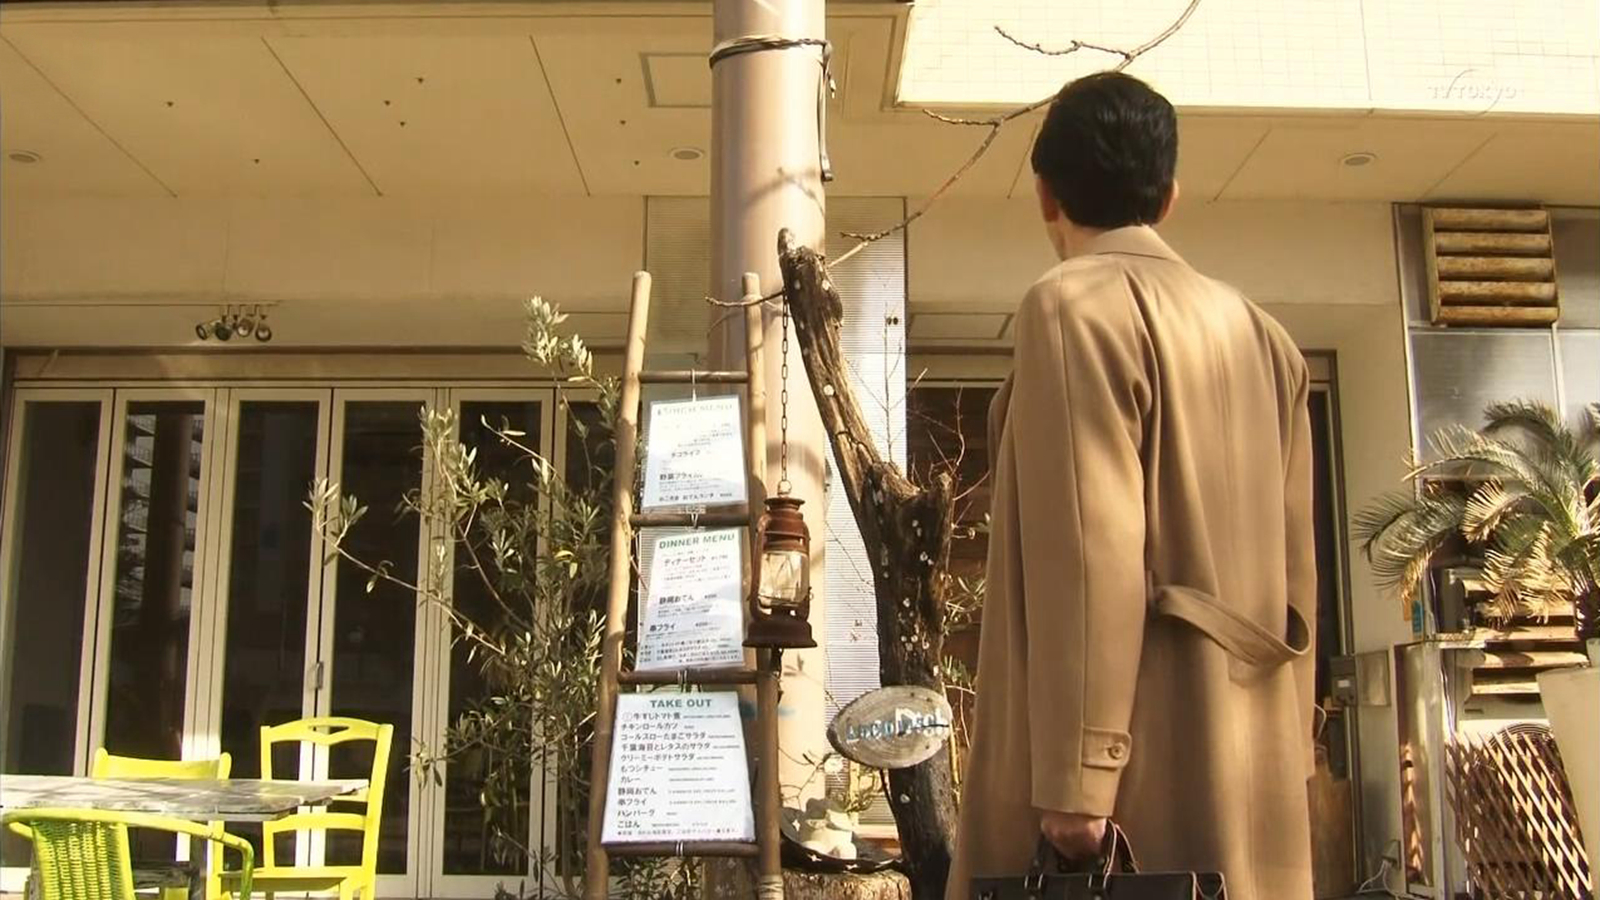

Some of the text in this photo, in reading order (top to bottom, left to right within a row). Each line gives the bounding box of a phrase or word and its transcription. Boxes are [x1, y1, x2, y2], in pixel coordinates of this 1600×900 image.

[659, 533, 735, 549] DINNER MENU
[663, 555, 706, 567] ディナーセット
[649, 699, 712, 708] TAKE OUT
[621, 723, 679, 731] チキンロールカツ
[620, 732, 706, 740] コールスローたまごサラダ
[620, 753, 695, 762] クリーミーポテトサラダ
[620, 764, 664, 773] もつシチュー
[620, 775, 641, 783] カレー
[618, 787, 657, 796] 静岡おでん
[617, 820, 640, 829] ごはん
